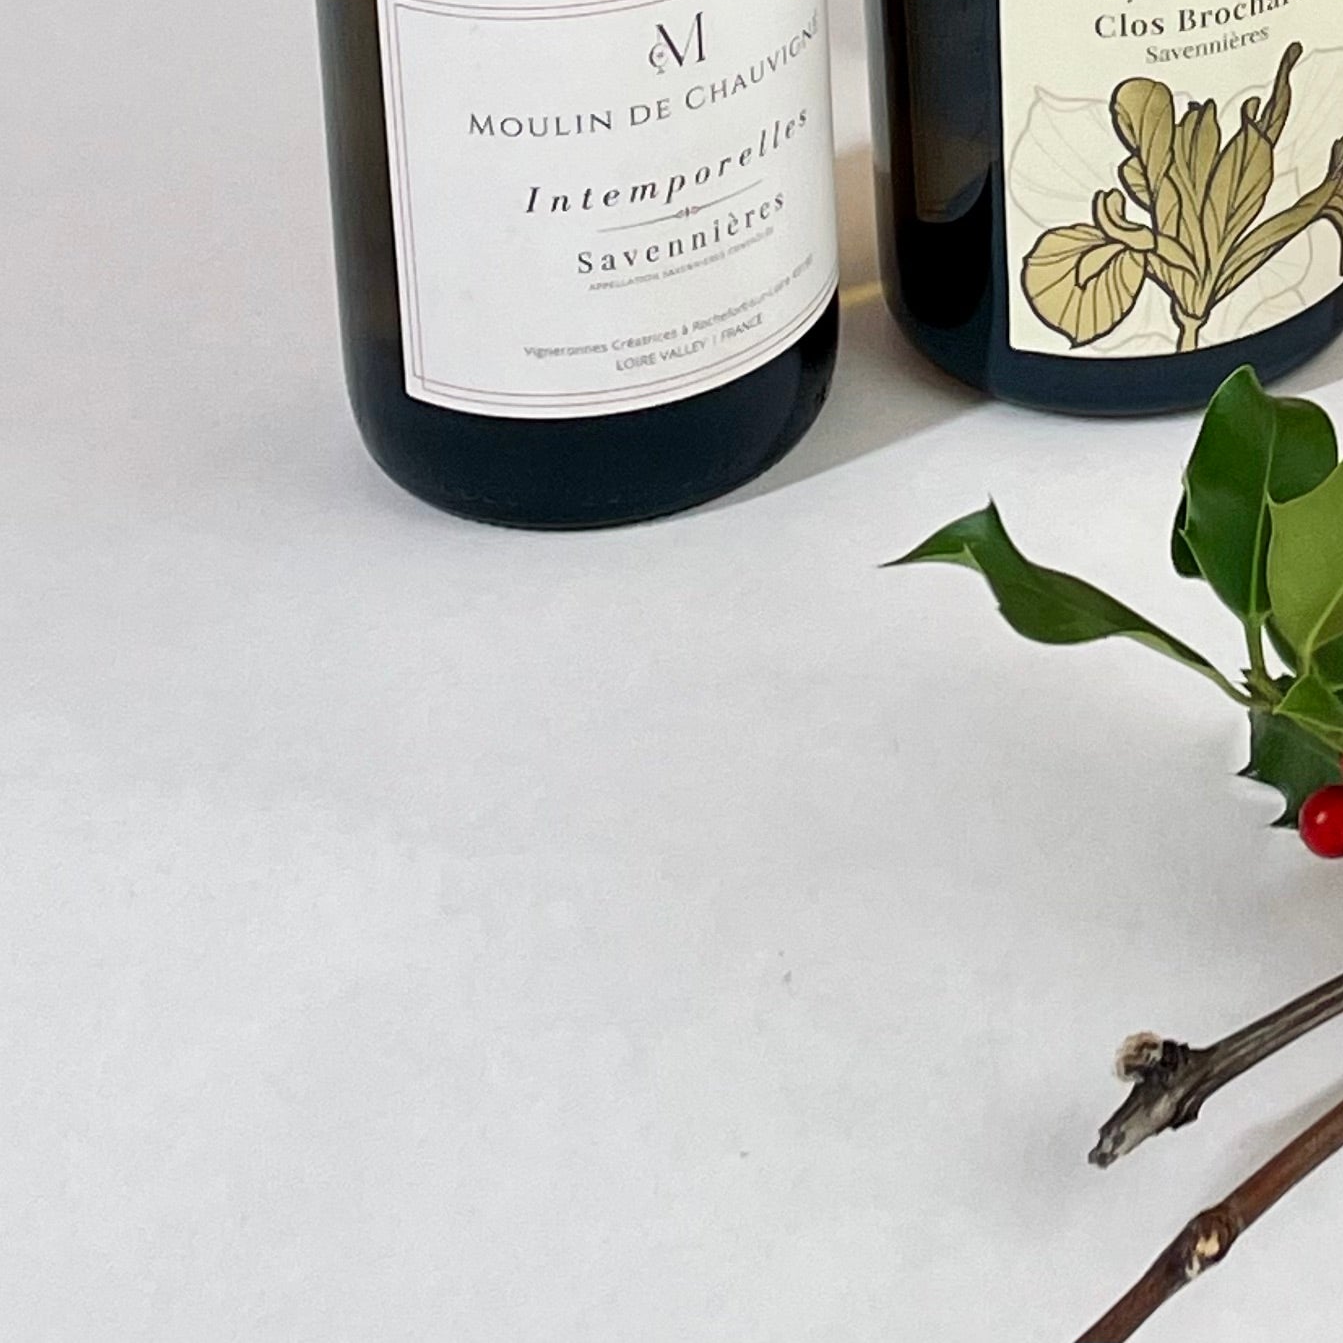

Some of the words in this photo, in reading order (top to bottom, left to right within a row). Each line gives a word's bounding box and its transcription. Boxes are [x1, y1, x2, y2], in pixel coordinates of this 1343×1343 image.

[1094, 14, 1165, 39] Clos
[1145, 25, 1270, 65] Savennières
[469, 110, 613, 138] MOULIN
[630, 98, 671, 127] DE
[525, 109, 808, 214] Intemporelles
[577, 192, 785, 275] Savennières
[523, 343, 609, 360] Vigneronnes
[616, 356, 657, 372] LOIRE
[659, 340, 707, 362] VALLEY
